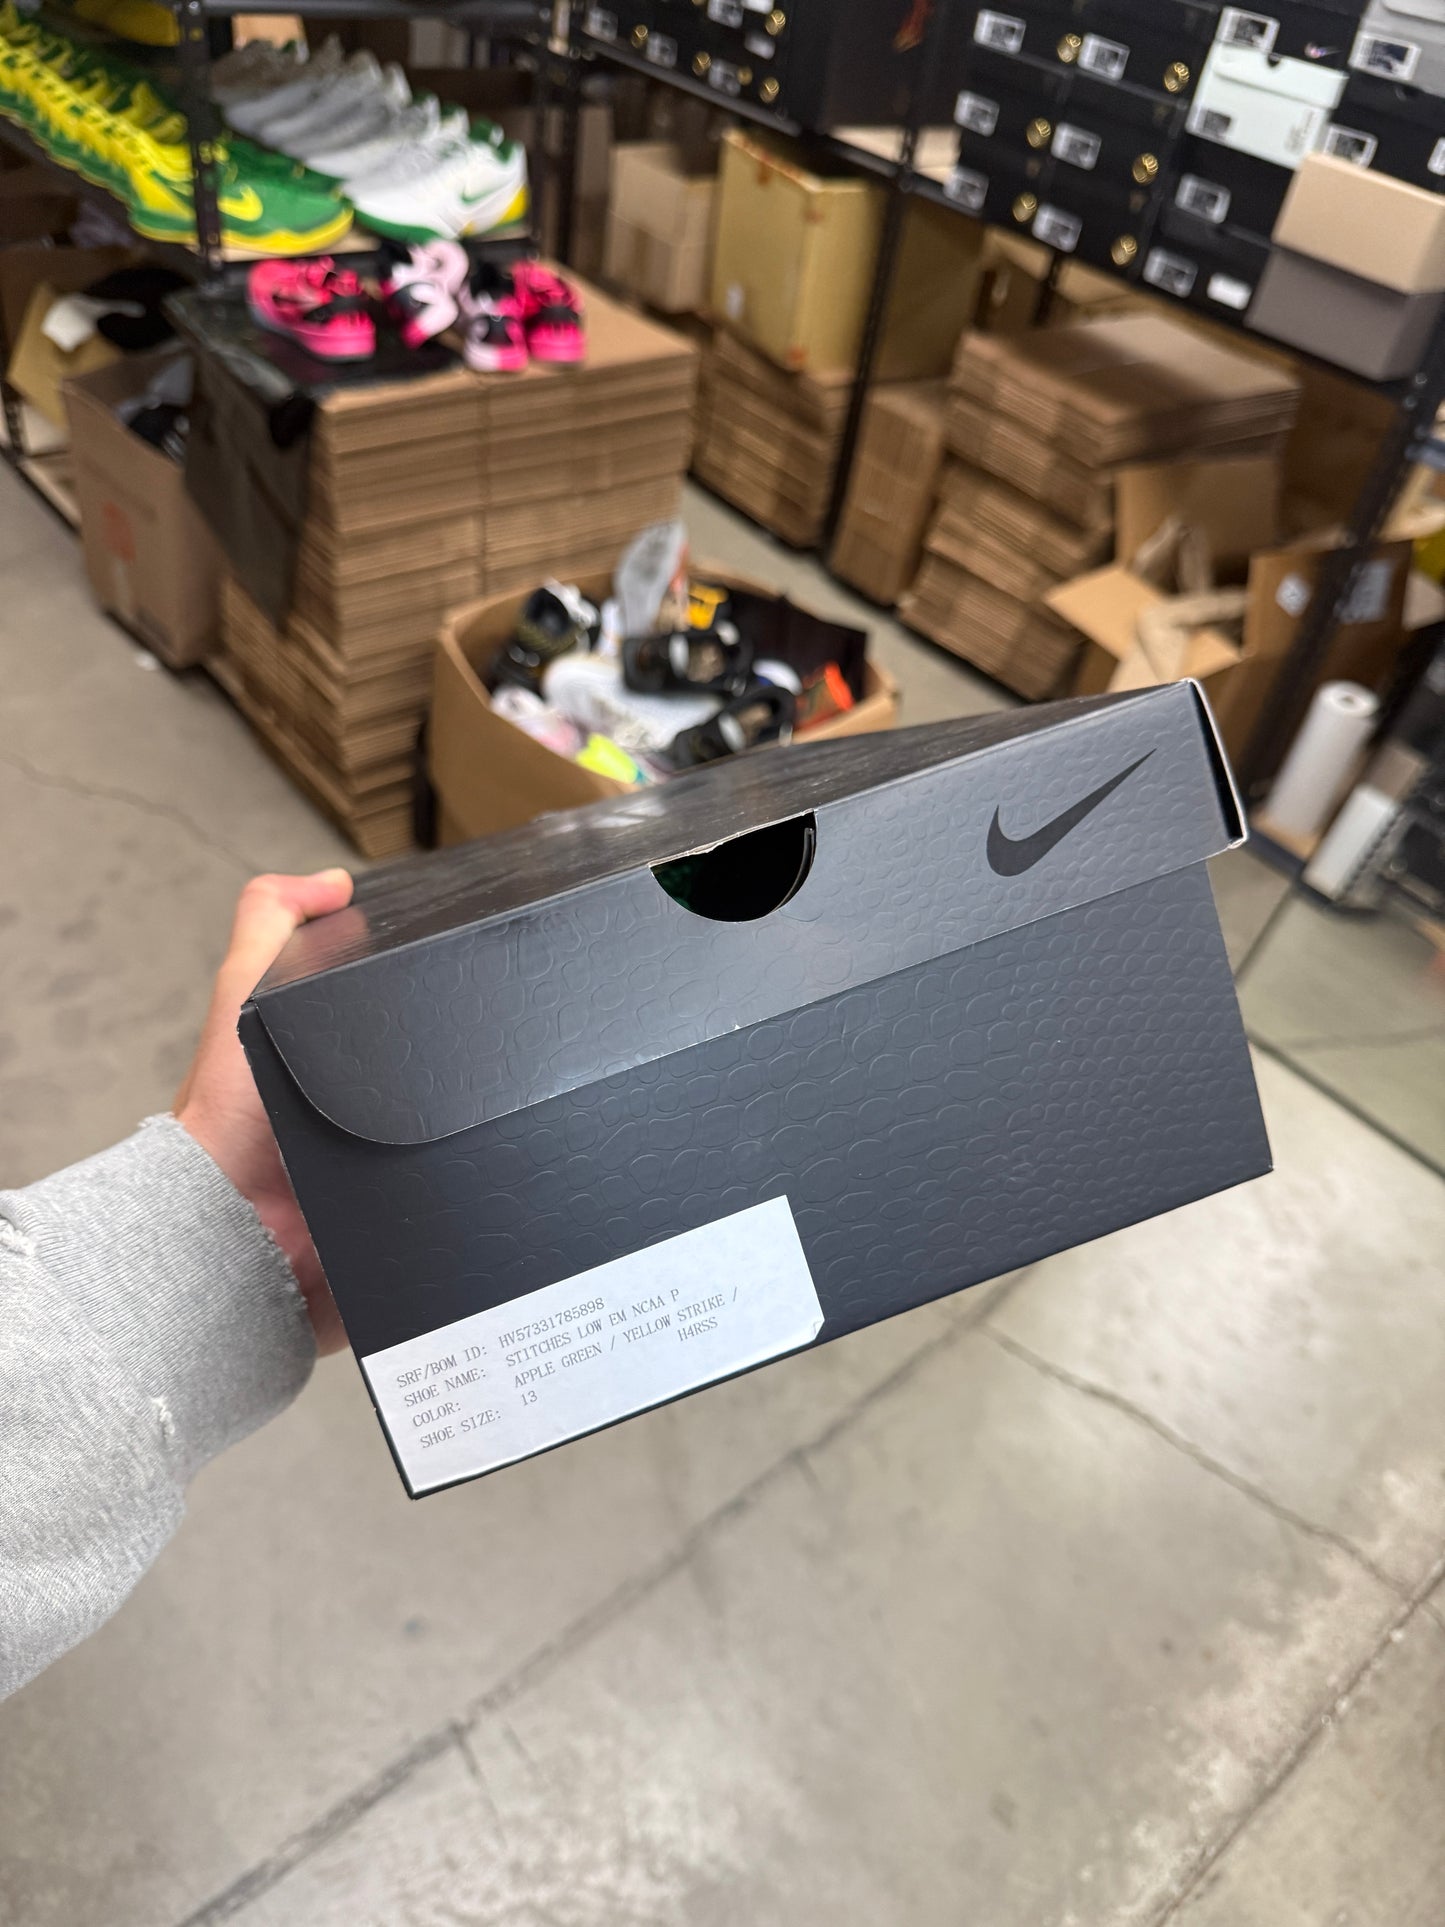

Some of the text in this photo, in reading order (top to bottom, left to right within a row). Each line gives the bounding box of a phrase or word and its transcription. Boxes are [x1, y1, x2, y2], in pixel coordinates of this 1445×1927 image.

[397, 1297, 605, 1388] SRF/BOM ID: HV57331785898
[404, 1288, 680, 1407] SHOE NAME: STITCHES LOW EM NCAA P
[412, 1401, 461, 1427] COLOR:
[515, 1361, 556, 1388] APPLE
[561, 1342, 603, 1368] GREEN
[622, 1314, 671, 1343] YELLOW
[677, 1294, 726, 1322] STRIKE
[420, 1390, 538, 1449] SHOE SIZE: 13
